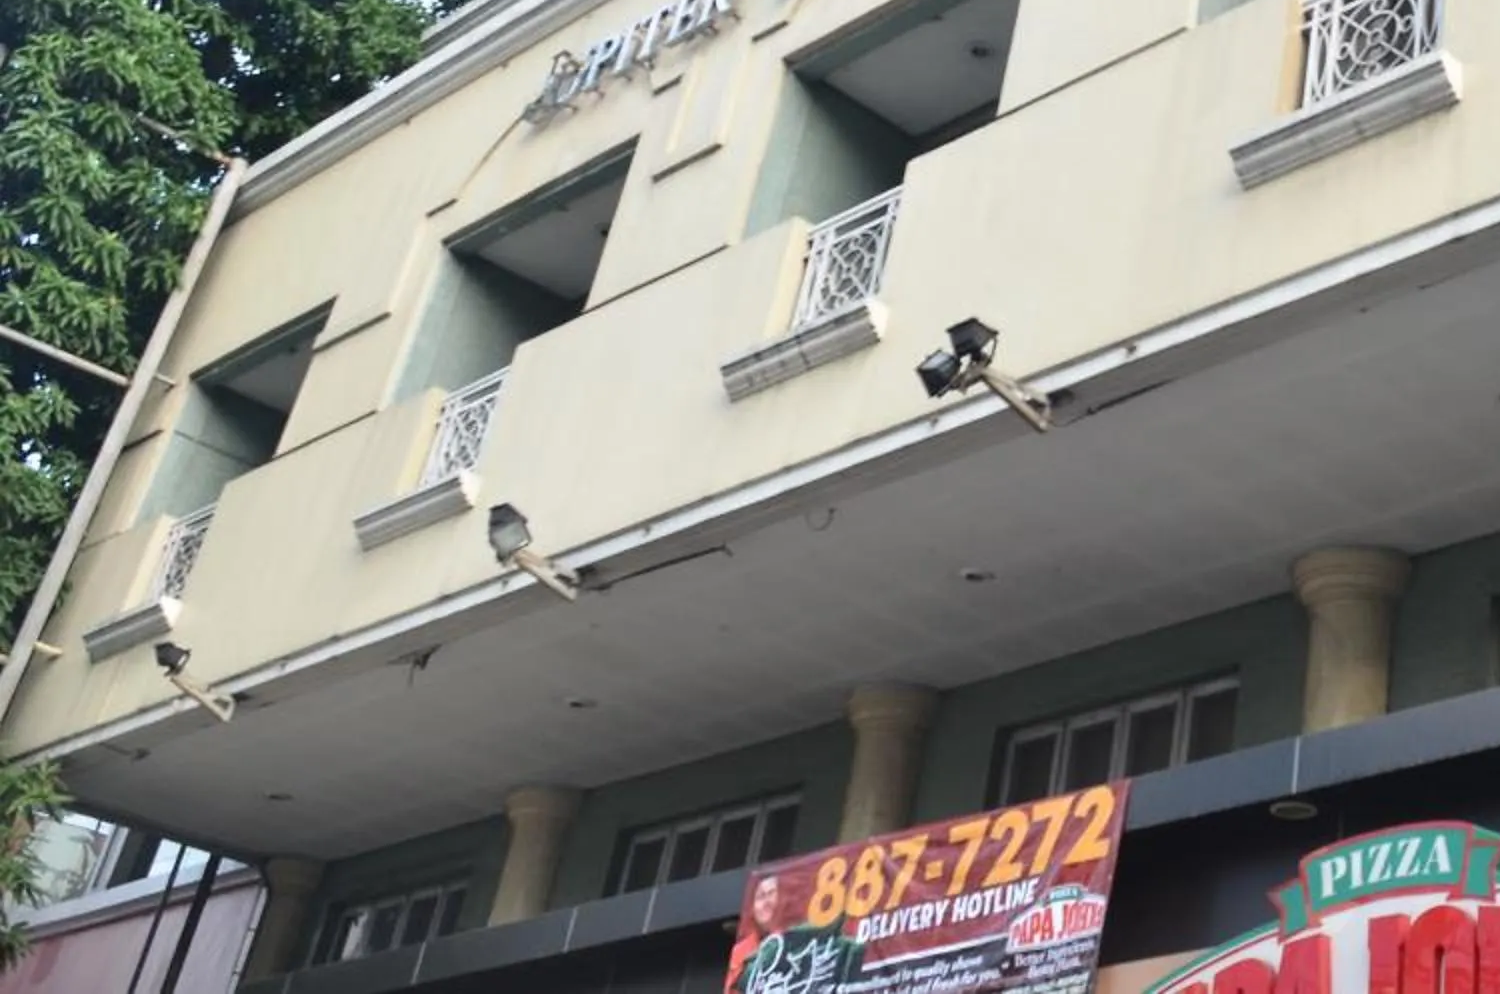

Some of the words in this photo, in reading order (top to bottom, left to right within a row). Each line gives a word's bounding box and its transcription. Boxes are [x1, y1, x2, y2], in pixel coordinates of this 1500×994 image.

[806, 784, 1118, 927] 887-7272
[1319, 834, 1452, 898] PIZZA
[856, 896, 953, 944] DELIVERY
[952, 877, 1040, 922] HOTLINE
